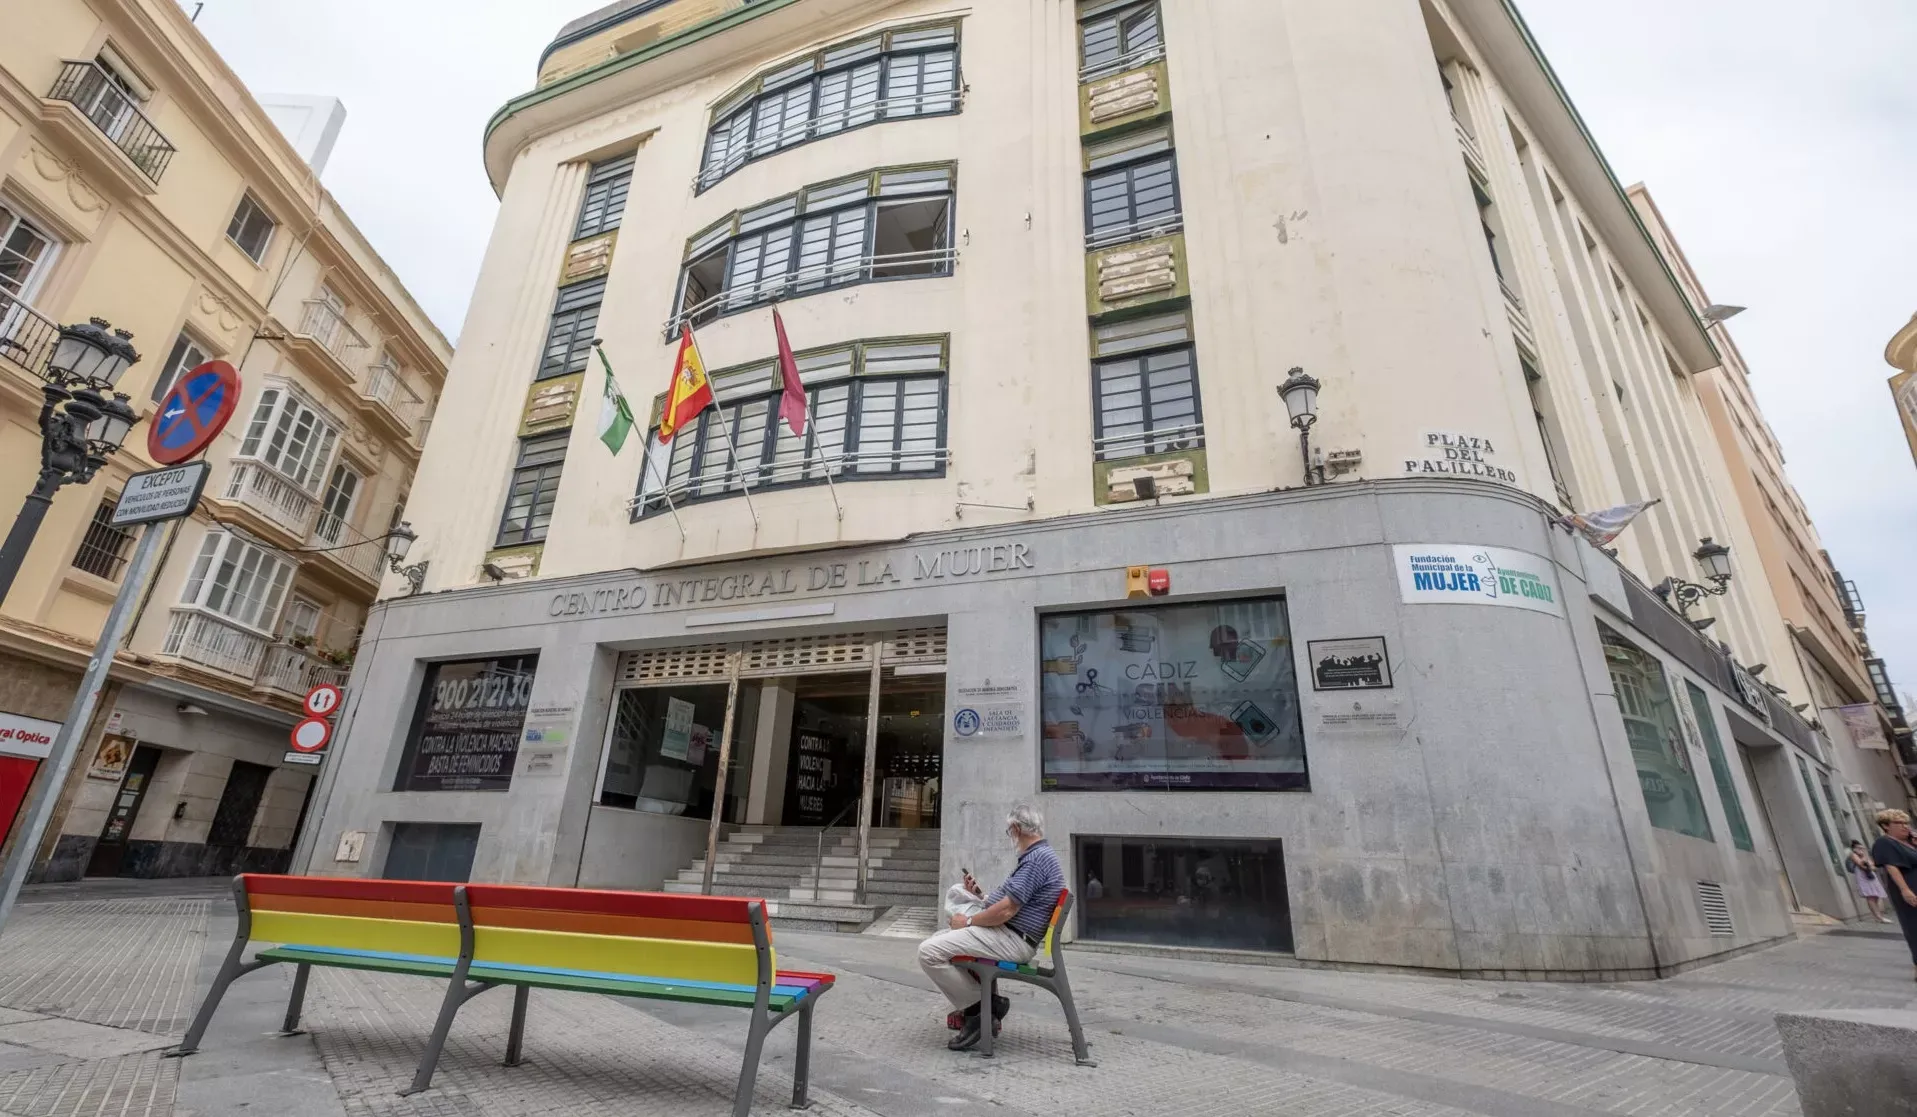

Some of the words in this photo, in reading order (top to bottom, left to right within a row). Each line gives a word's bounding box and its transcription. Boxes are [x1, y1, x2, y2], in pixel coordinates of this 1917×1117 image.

[1427, 433, 1494, 453] PLAZA
[1445, 448, 1484, 463] DEL
[141, 469, 186, 489] EXCEPTO
[1405, 460, 1516, 483] PALILLERO
[162, 485, 193, 498] PERSONAS
[117, 507, 129, 517] CON
[128, 502, 160, 516] MOVILIDAD
[1410, 554, 1456, 564] Fundación
[1411, 563, 1453, 572] Municipal
[1455, 564, 1464, 572] de
[1465, 564, 1474, 572] la
[549, 585, 647, 618] CENTRO
[652, 568, 797, 607] INTEGRAL
[806, 563, 848, 592] DE
[857, 560, 901, 586] LA
[913, 542, 1034, 581] MUJER
[1413, 572, 1482, 592] MUJER
[1499, 575, 1519, 596] DE
[1125, 658, 1198, 680] CÁDIZ
[435, 679, 468, 709] 900
[466, 678, 488, 708] 21
[486, 676, 509, 708] 21
[507, 676, 533, 707] 30
[1134, 681, 1193, 707] SIN
[1123, 707, 1206, 720] VIOLENCIAS
[16, 729, 51, 745] Optica
[421, 735, 447, 754] CONTRA
[446, 735, 456, 753] LA
[455, 733, 488, 753] VIOLENCIA
[800, 735, 822, 751] CONTRA
[427, 754, 449, 774] BASTA
[448, 754, 460, 773] DE
[799, 775, 815, 790] HACIA
